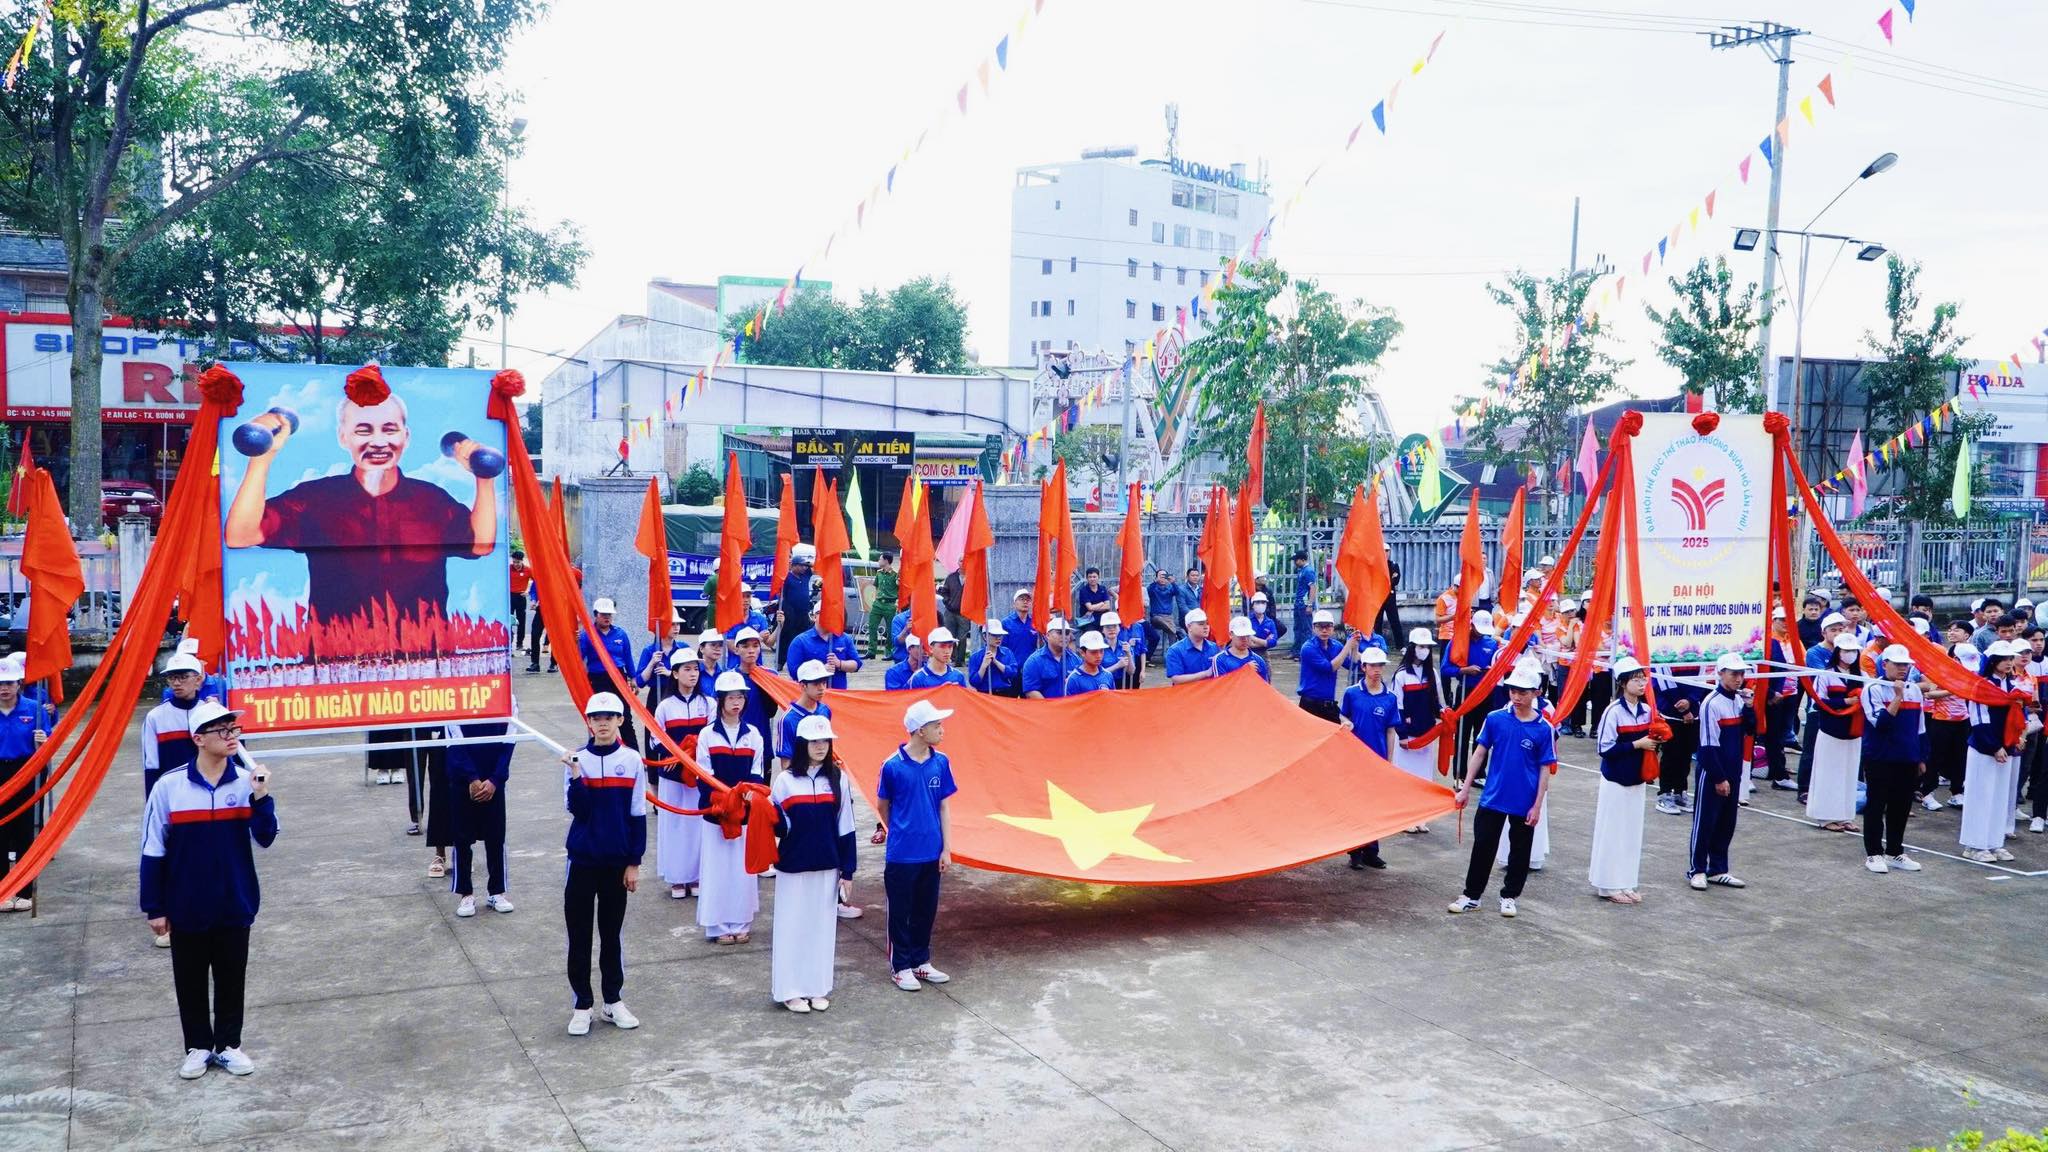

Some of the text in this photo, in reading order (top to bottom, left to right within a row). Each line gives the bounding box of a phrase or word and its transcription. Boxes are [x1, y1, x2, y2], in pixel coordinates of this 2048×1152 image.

[34, 333, 158, 355] SOP
[1682, 537, 1709, 548] 2025
[1673, 582, 1714, 599] ĐẠI HỘI
[1673, 604, 1693, 617] THAO
[1728, 602, 1750, 615] BUÔN
[1693, 621, 1711, 635] NĂM
[1713, 623, 1732, 635] 2025
[281, 691, 311, 722] TÔI
[316, 690, 365, 719] NGÀY
[368, 687, 404, 715] NÀO
[410, 684, 456, 713] CŨNG
